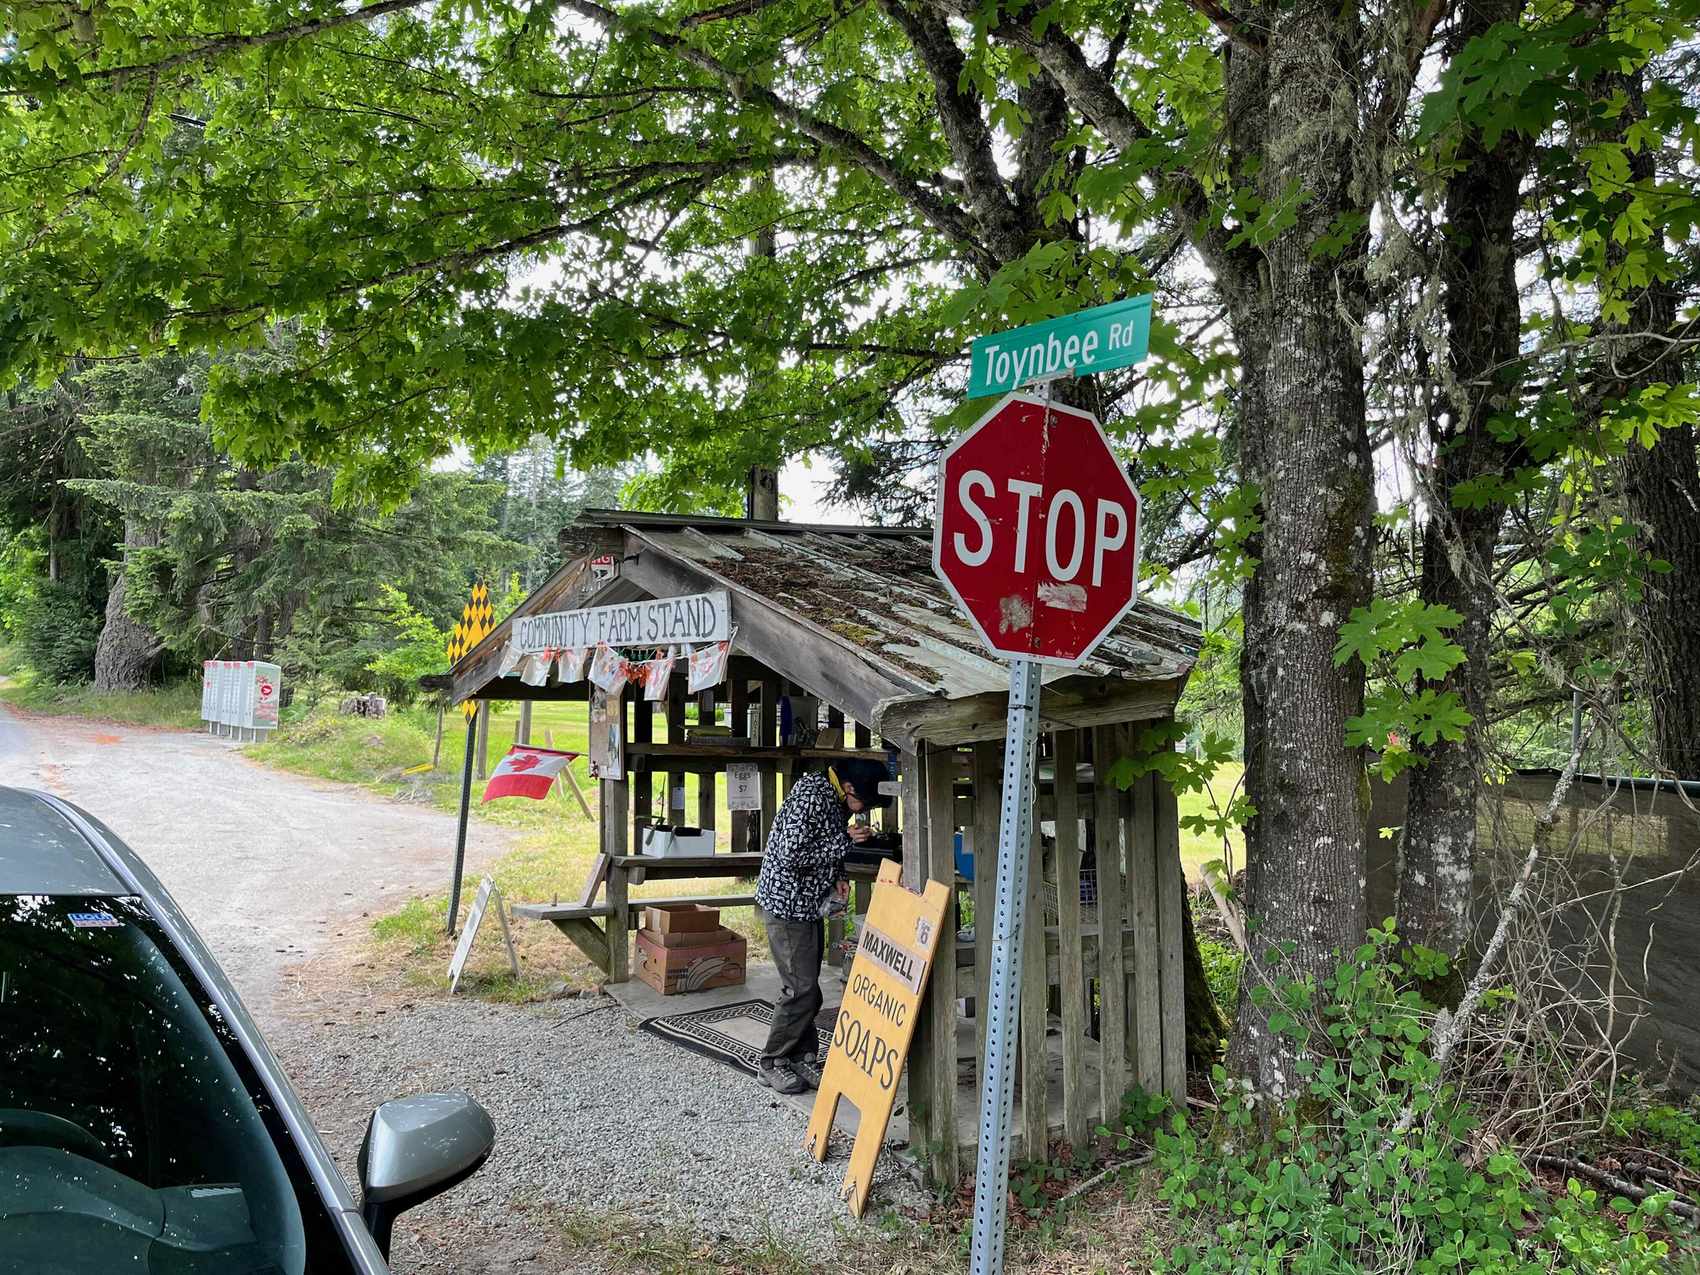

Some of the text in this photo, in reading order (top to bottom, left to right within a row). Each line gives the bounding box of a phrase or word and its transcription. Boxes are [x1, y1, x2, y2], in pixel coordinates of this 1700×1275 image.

[985, 320, 1134, 390] Toynbee Rd
[954, 470, 1128, 587] STOP
[520, 596, 716, 649] COMMUNITY FARM STAND
[863, 930, 914, 983] MAXWELL
[852, 973, 907, 1028] ORGANIC
[834, 1010, 899, 1090] SOAPS
